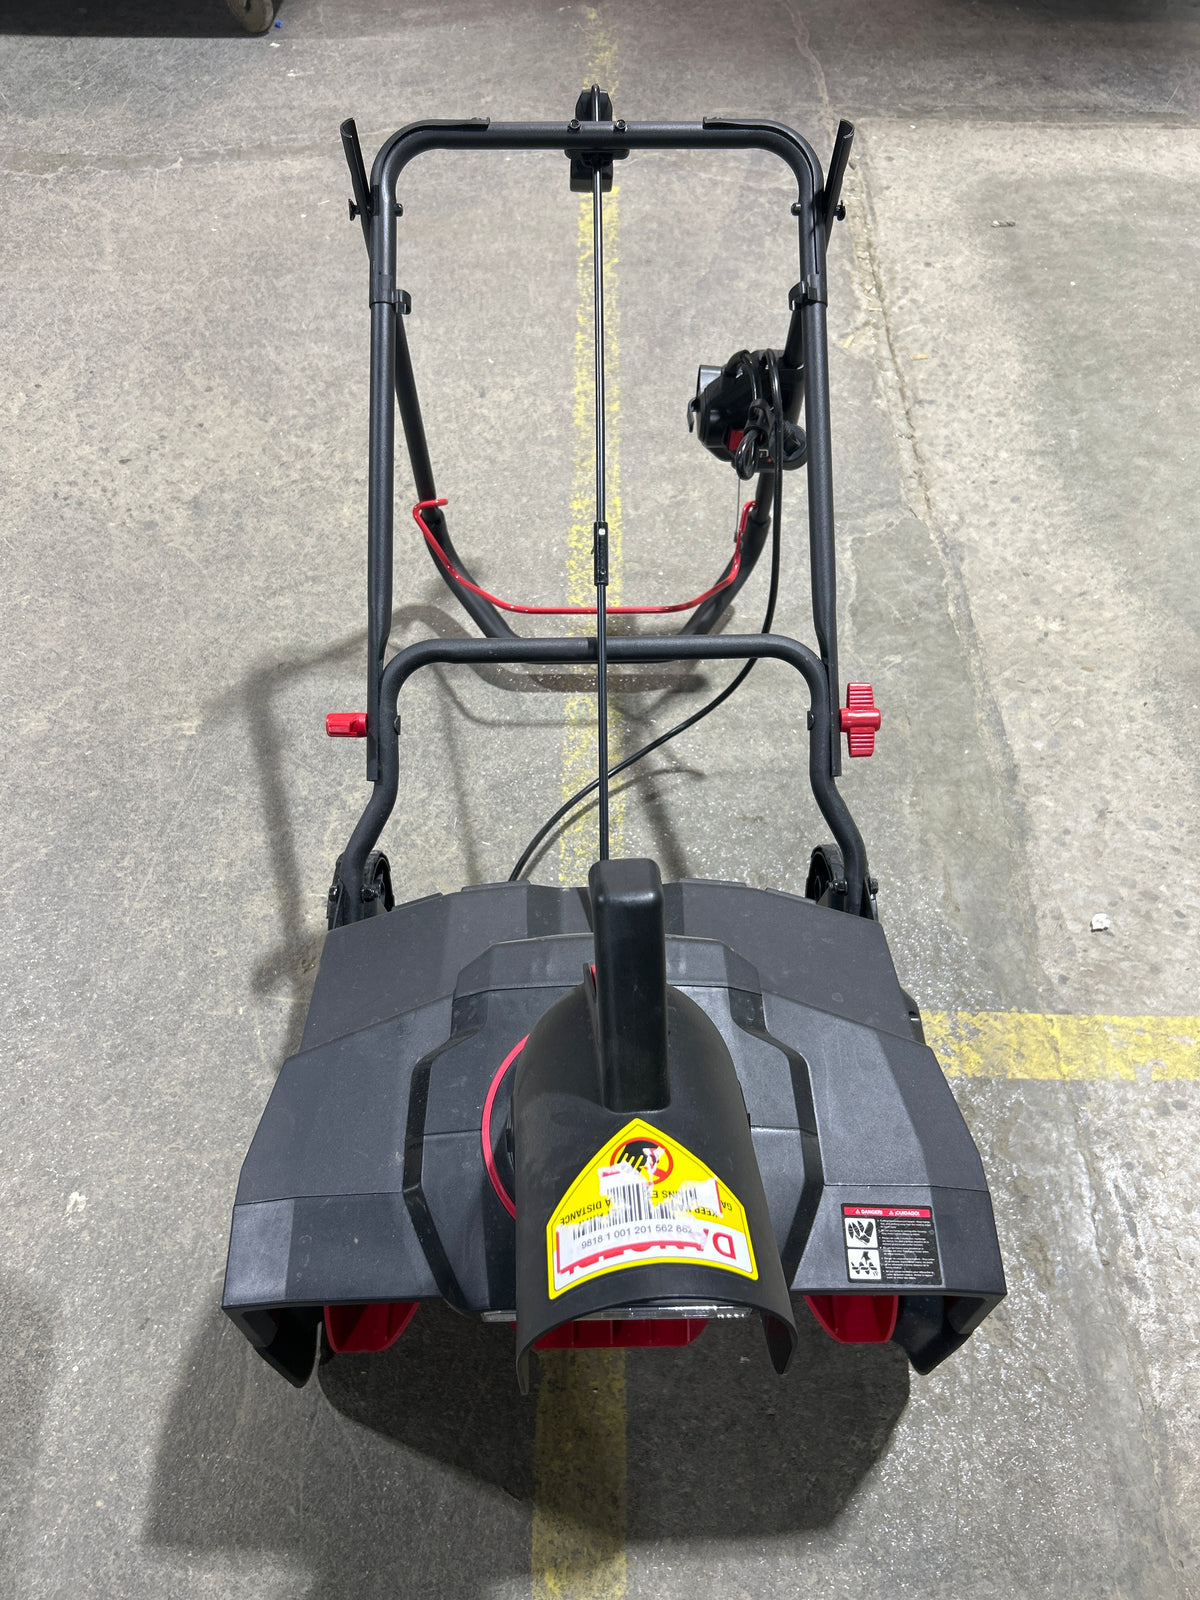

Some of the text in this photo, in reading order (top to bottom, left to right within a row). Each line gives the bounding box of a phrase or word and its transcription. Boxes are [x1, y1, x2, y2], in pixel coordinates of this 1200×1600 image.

[560, 1200, 602, 1225] DISTANCE
[581, 1235, 603, 1249] 9818
[606, 1232, 611, 1240] 1
[614, 1228, 631, 1238] 001
[634, 1225, 652, 1234] 201
[655, 1224, 673, 1232] 562
